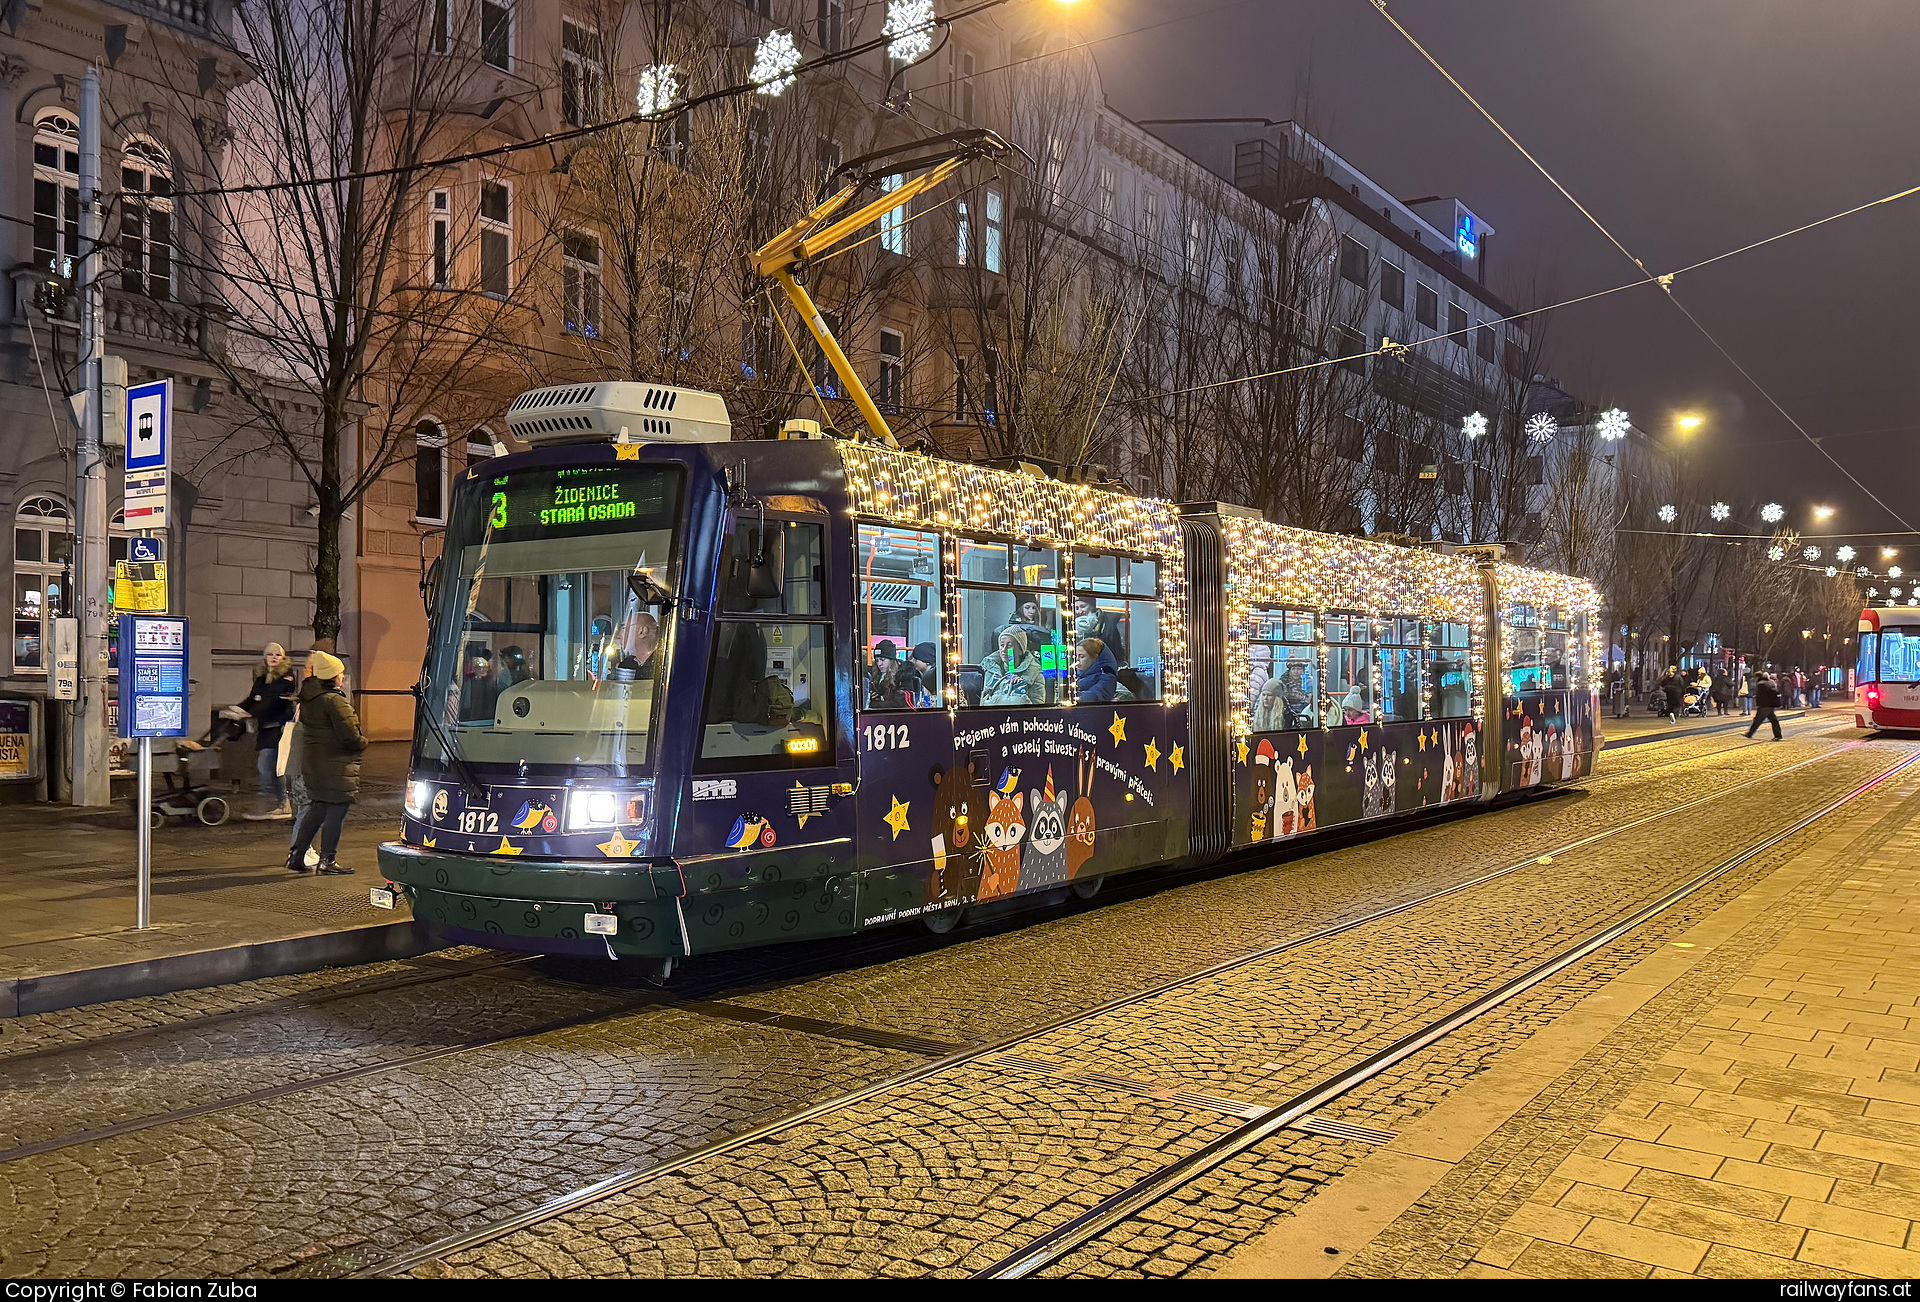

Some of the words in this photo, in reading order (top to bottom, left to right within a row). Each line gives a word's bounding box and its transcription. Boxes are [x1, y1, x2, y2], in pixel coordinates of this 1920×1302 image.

[555, 484, 619, 505] ŽIDENICE
[492, 492, 507, 529] 3
[540, 503, 584, 525] STARÁ
[588, 501, 636, 521] OSADA
[863, 724, 911, 751] 1812
[999, 716, 1019, 734] vám
[1023, 717, 1064, 734] pohodové
[1068, 723, 1097, 745] Vánoce
[1002, 746, 1009, 757] a
[1012, 738, 1041, 757] veselý
[1044, 740, 1077, 757] Silvestr
[1085, 750, 1090, 761] s
[1096, 755, 1127, 782] pravými
[1128, 775, 1154, 807] přáteli.
[457, 811, 499, 833] 1812
[864, 908, 897, 927] DOPRAVNÍ
[898, 907, 921, 919] PODNIK
[922, 901, 942, 914] MĚSTA
